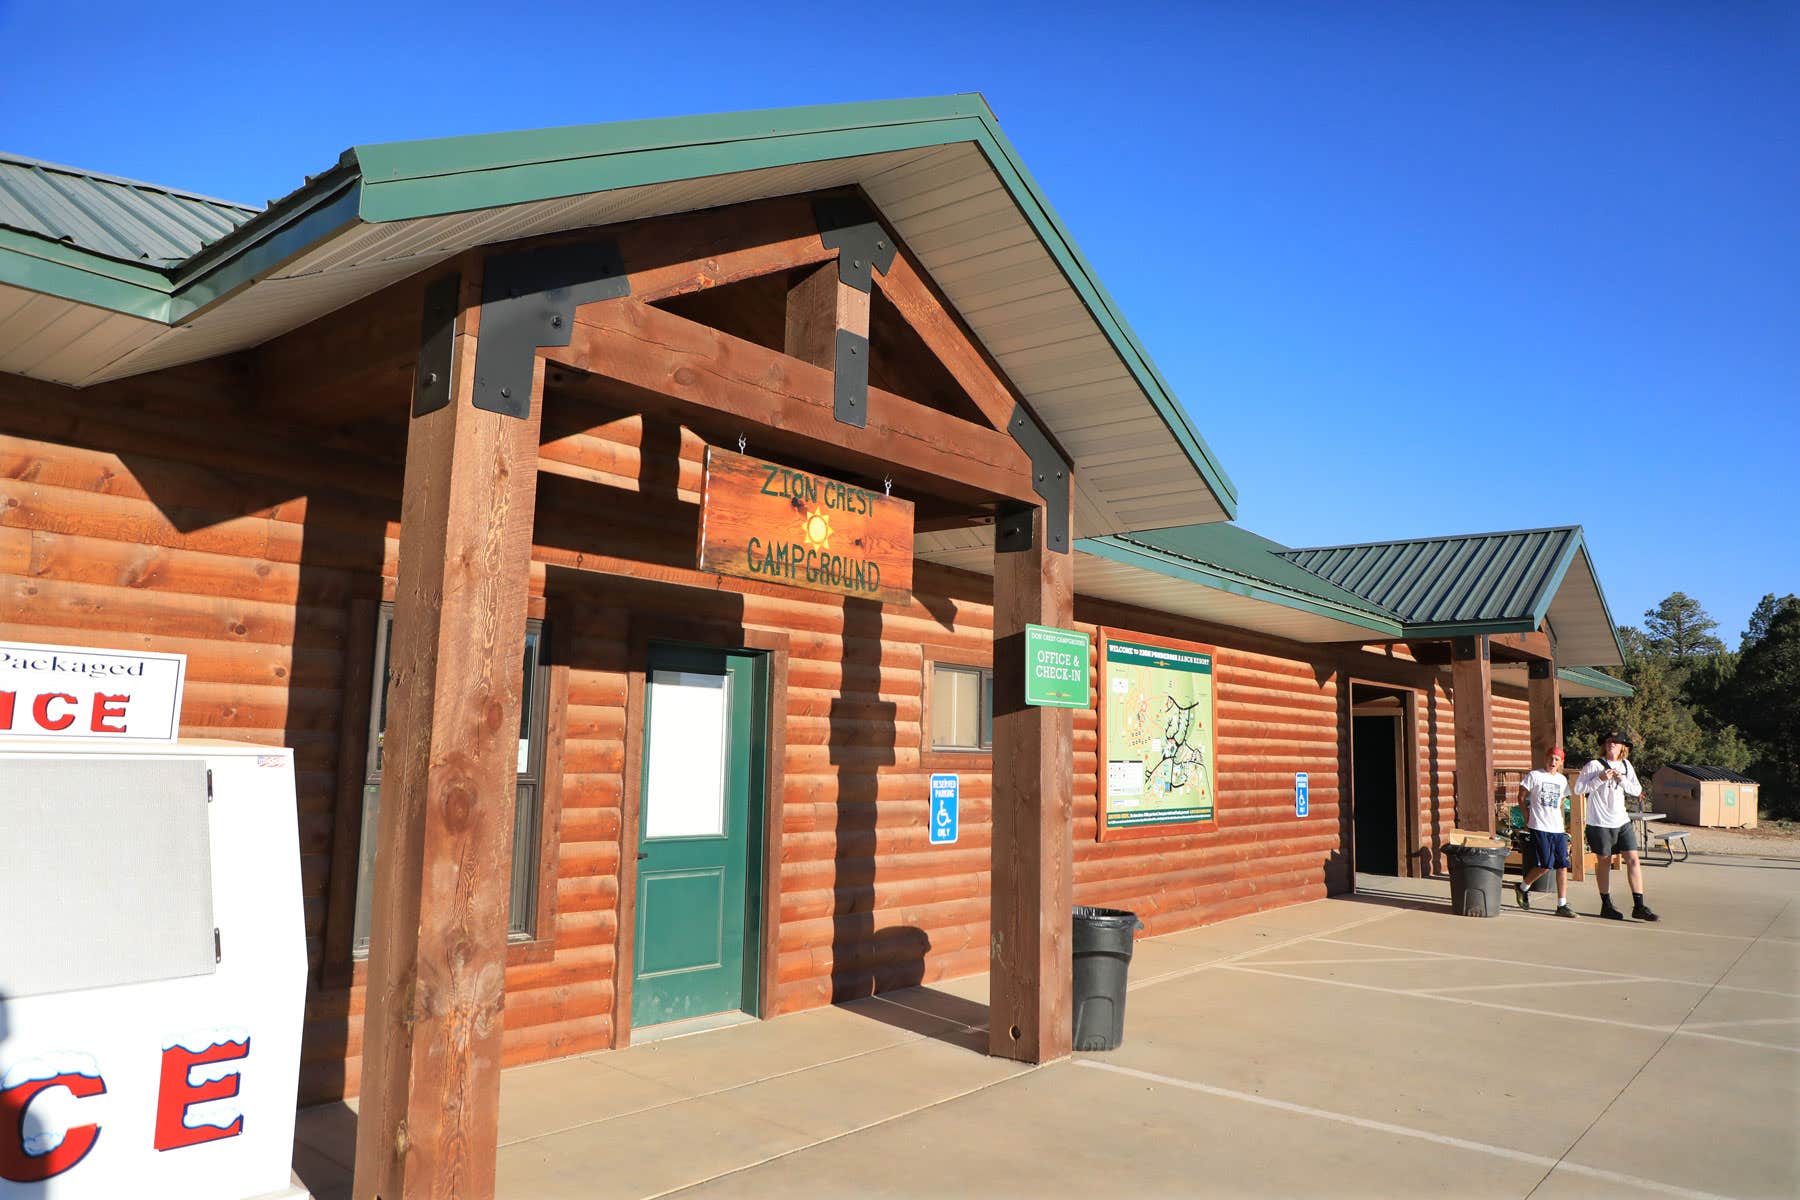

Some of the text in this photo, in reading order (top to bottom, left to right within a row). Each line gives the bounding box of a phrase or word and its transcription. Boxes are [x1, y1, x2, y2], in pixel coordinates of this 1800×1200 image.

[760, 464, 877, 517] ZION CREST
[747, 537, 881, 592] CAMPGROUND
[1036, 664, 1081, 682] CHECK-IN
[1037, 650, 1080, 667] OFFICE &
